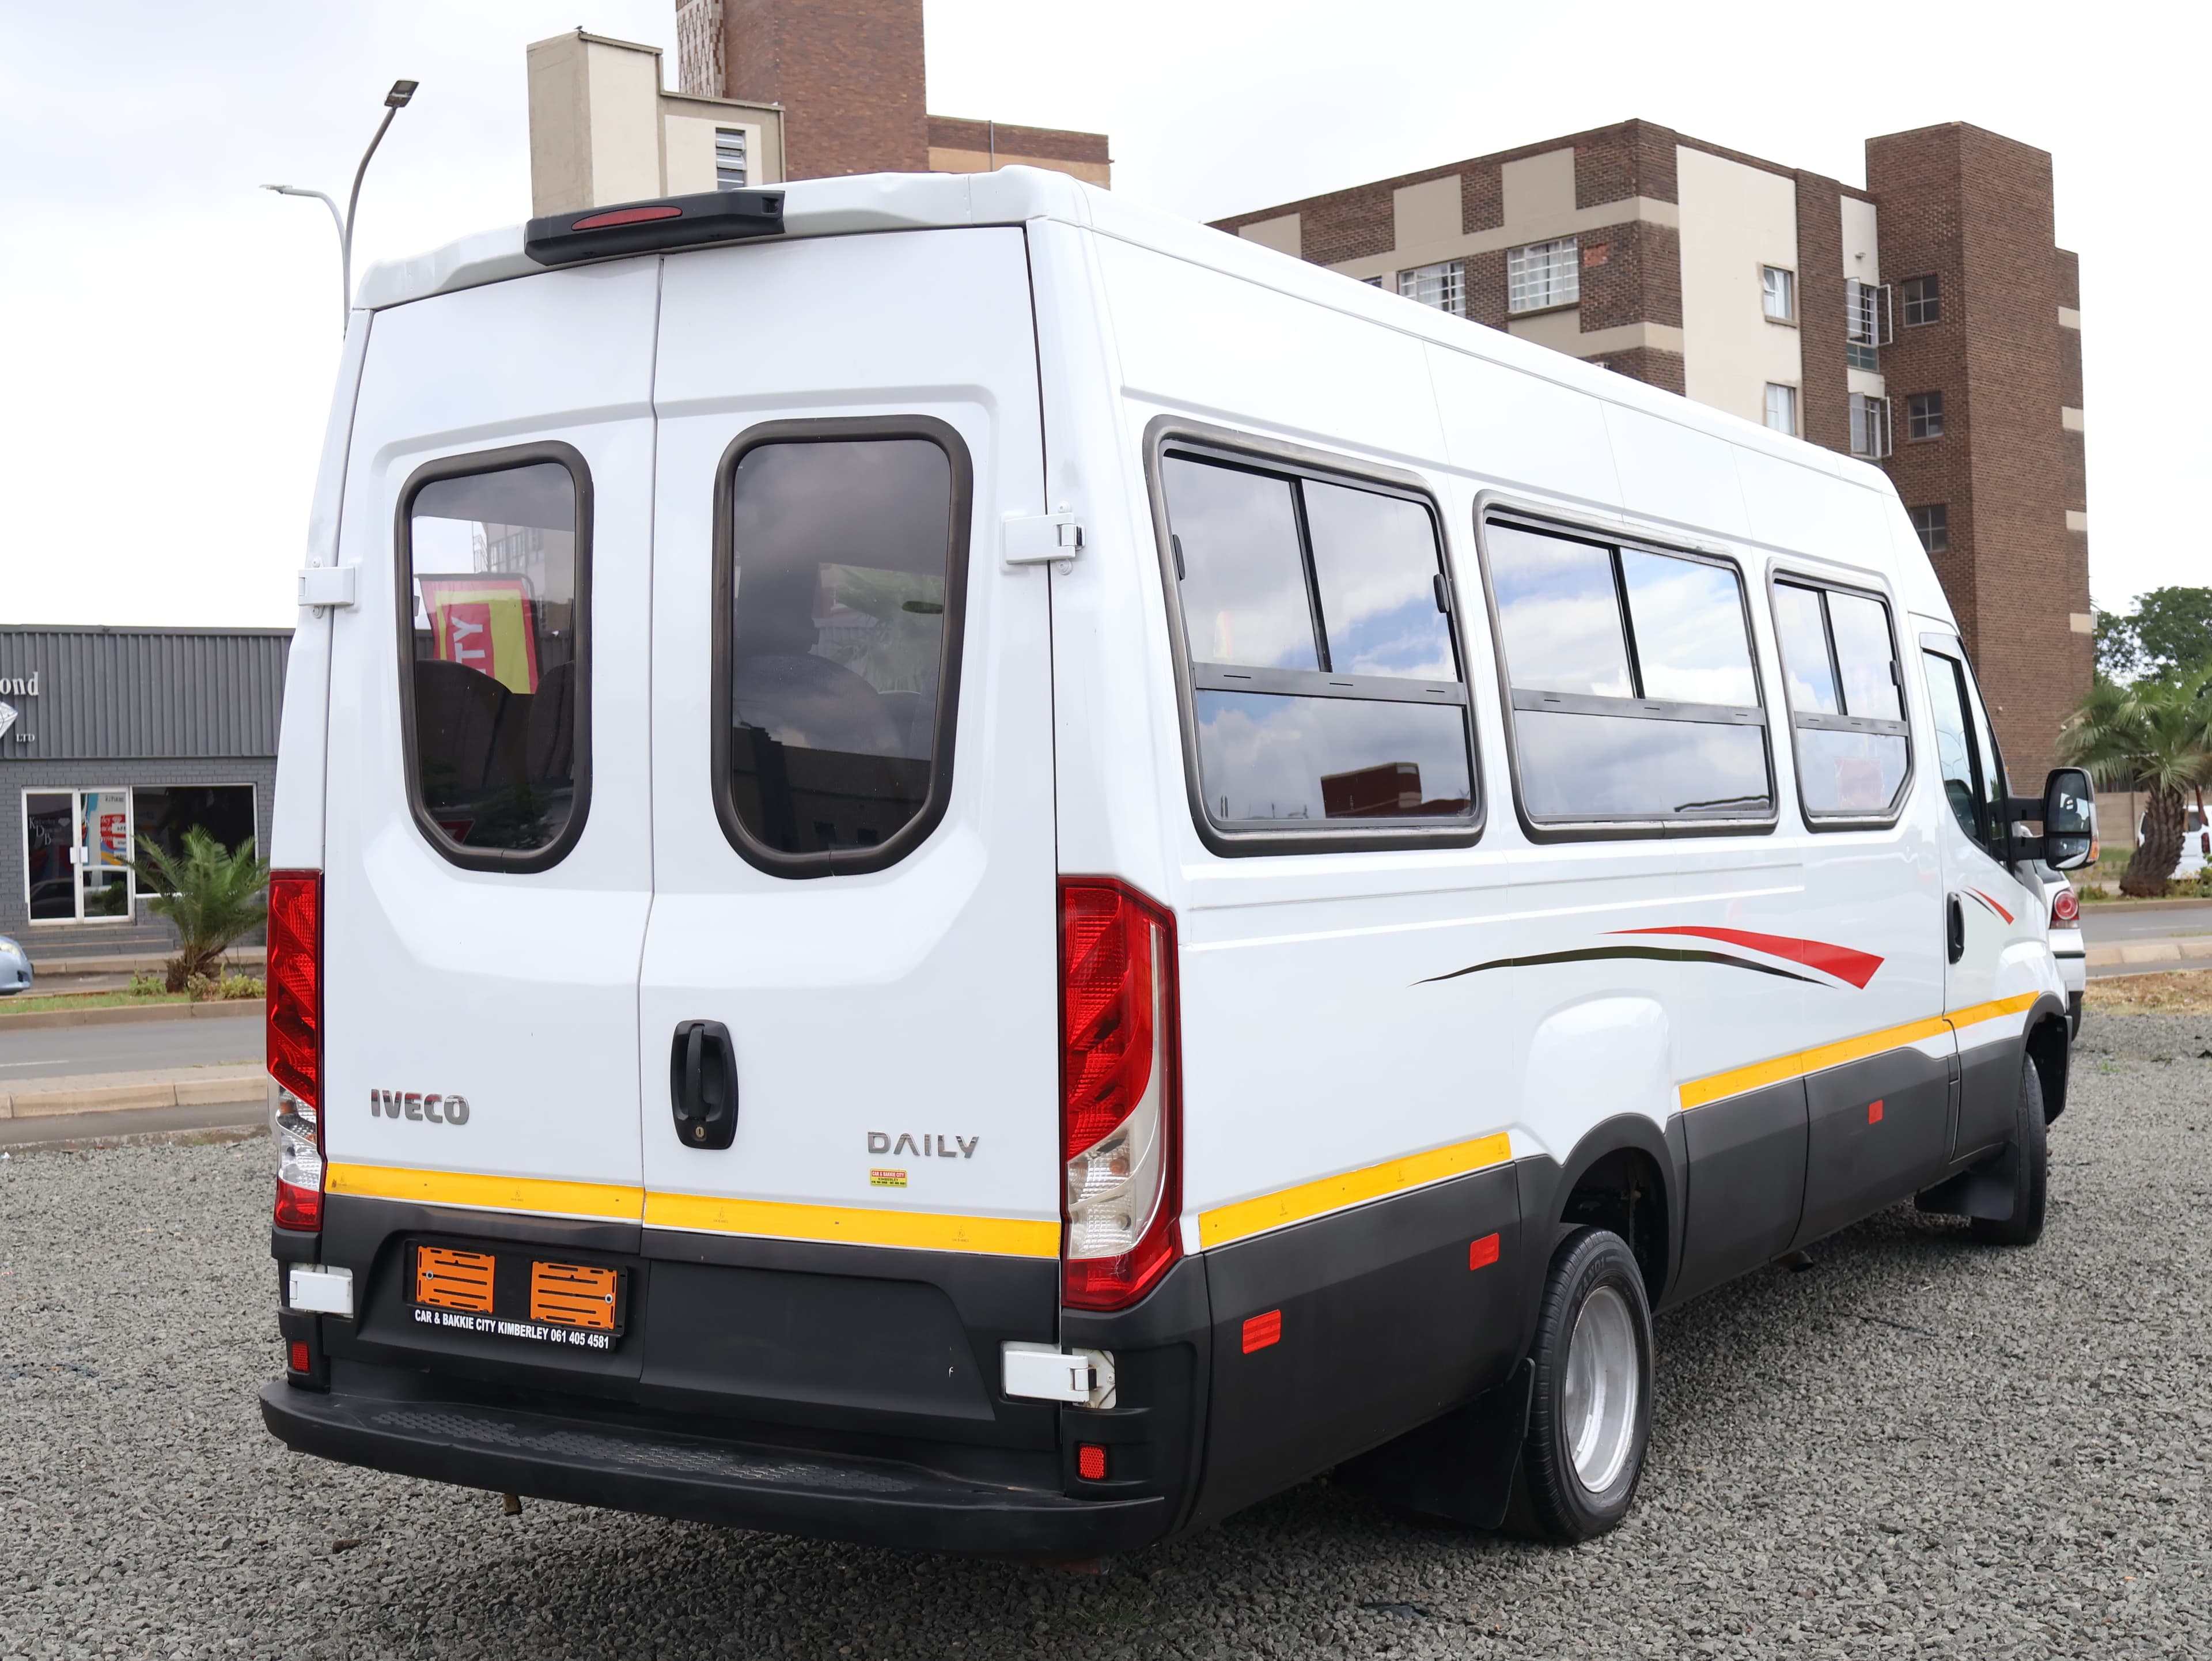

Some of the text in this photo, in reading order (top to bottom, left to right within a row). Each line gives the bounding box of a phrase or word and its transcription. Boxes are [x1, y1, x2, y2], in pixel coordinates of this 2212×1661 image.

[16, 733, 35, 743] LTD
[371, 1088, 470, 1125] IVECO
[868, 1131, 980, 1159] DAILY
[415, 1309, 609, 1349] CAR & BAKKIE CITY KIMBERLEY 061 405 4581
